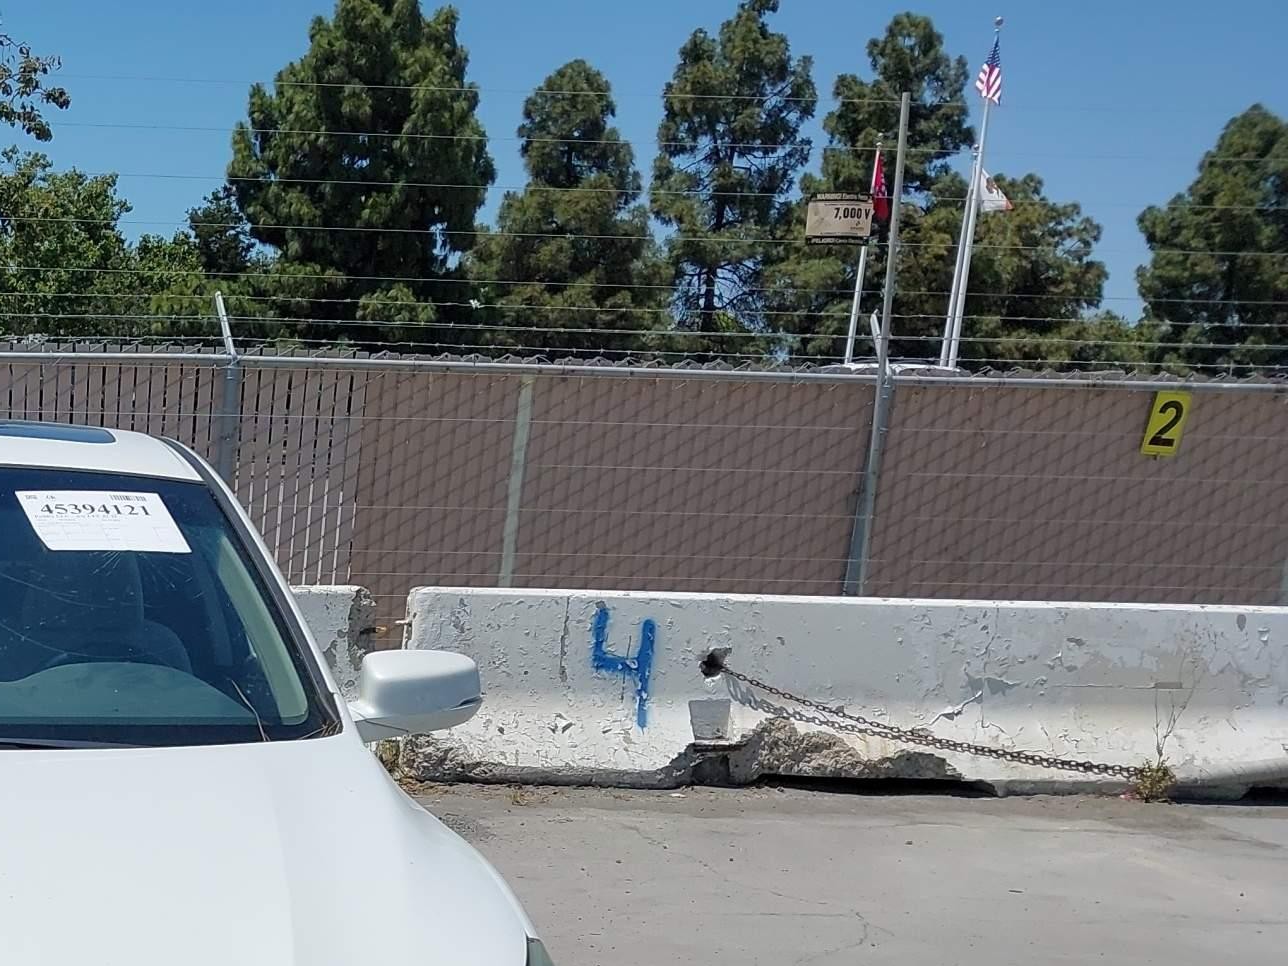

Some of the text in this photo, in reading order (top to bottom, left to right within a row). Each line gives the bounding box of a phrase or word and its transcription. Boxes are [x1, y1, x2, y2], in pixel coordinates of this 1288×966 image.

[834, 207, 871, 220] 7,000 V
[1148, 400, 1184, 447] 2
[40, 503, 152, 516] 45394121
[590, 600, 657, 728] 4
